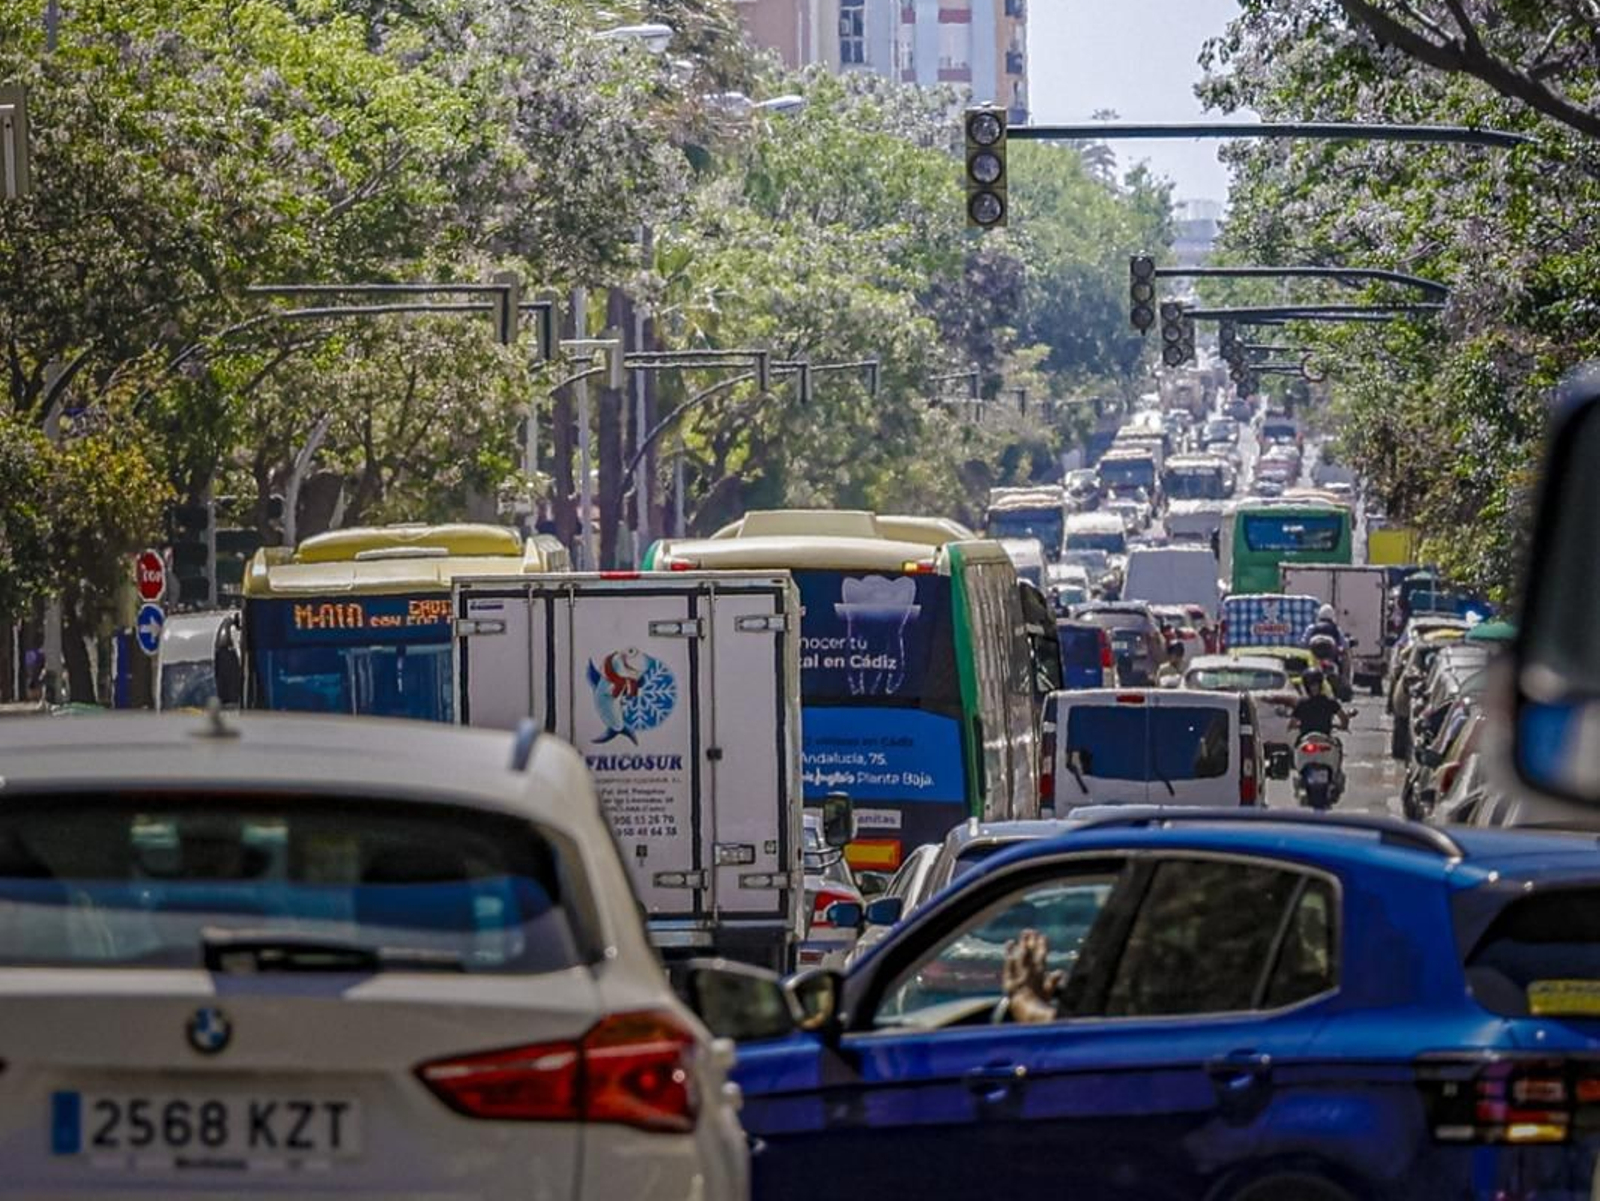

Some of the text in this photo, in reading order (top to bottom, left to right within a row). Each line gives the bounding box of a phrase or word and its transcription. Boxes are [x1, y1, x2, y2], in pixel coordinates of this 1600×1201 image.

[824, 657, 845, 668] en
[850, 653, 897, 669] Cádiz
[92, 1099, 348, 1149] 2568 KZT
